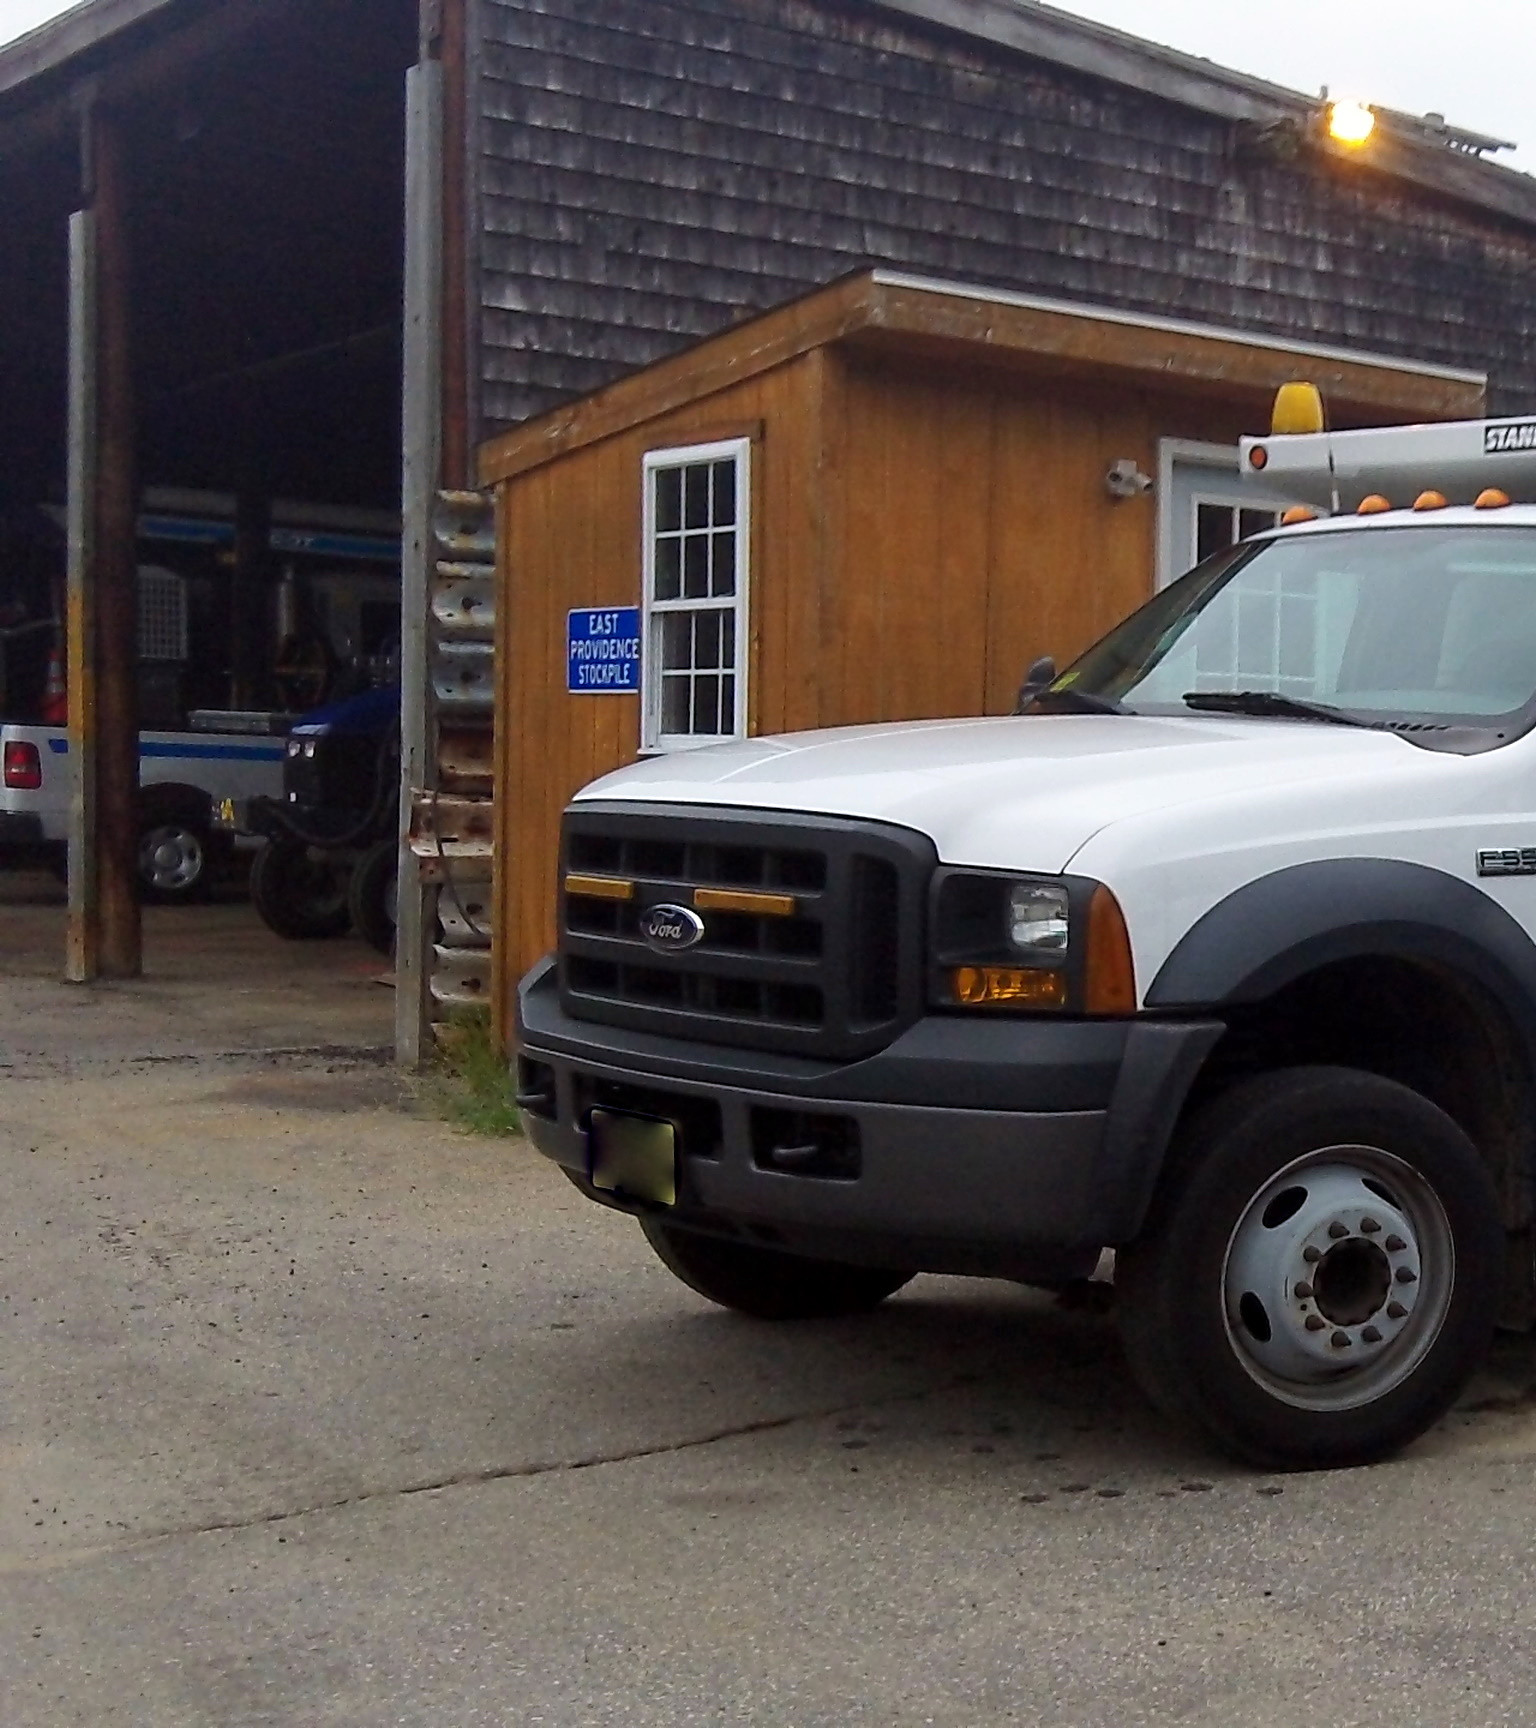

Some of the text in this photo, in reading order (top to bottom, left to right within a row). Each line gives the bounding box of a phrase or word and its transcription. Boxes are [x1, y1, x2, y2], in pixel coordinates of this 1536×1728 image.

[589, 613, 619, 635] EAST
[570, 638, 640, 660] PROVIDENCE
[578, 663, 631, 685] STOCKPILE
[648, 910, 684, 939] Ford
